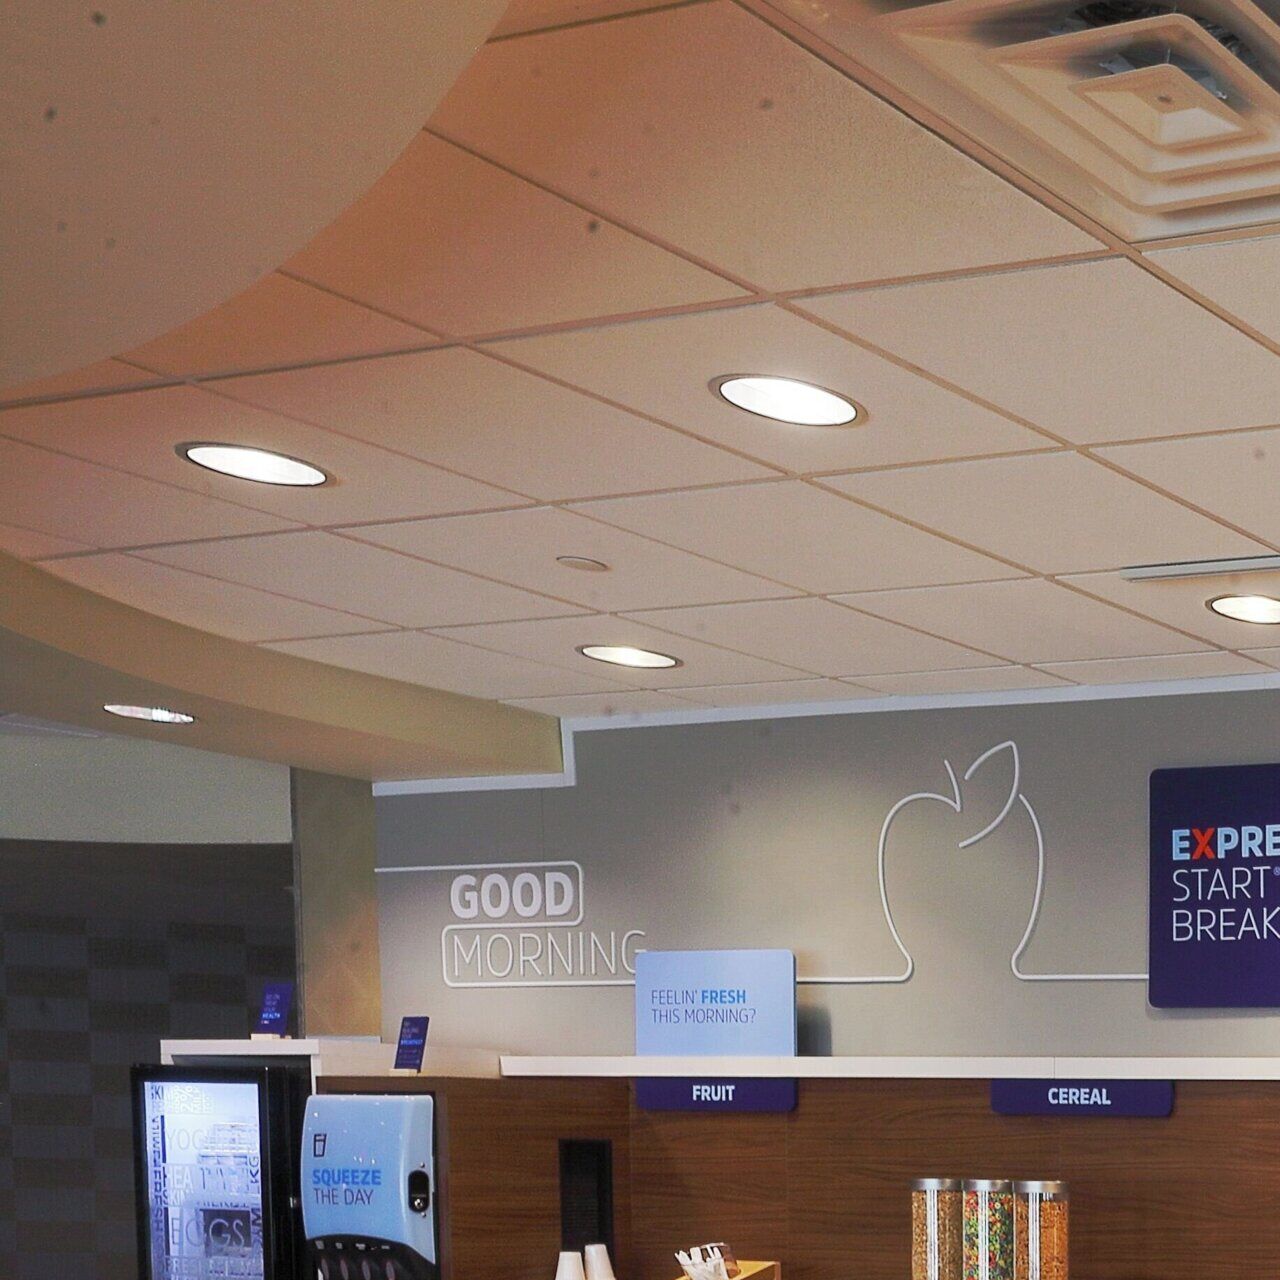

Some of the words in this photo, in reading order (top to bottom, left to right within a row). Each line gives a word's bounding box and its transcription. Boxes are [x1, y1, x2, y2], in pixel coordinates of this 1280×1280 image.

[450, 872, 574, 919] GOOD
[453, 930, 646, 977] MORNING
[701, 989, 746, 1004] FRESH
[651, 1008, 680, 1024] THIS
[684, 1008, 756, 1024] MORNING?
[692, 1085, 735, 1101] FRUIT
[1047, 1087, 1112, 1105] CEREAL
[312, 1169, 381, 1186] SQUEEZE
[314, 1188, 339, 1205] THE
[344, 1188, 374, 1205] DAY
